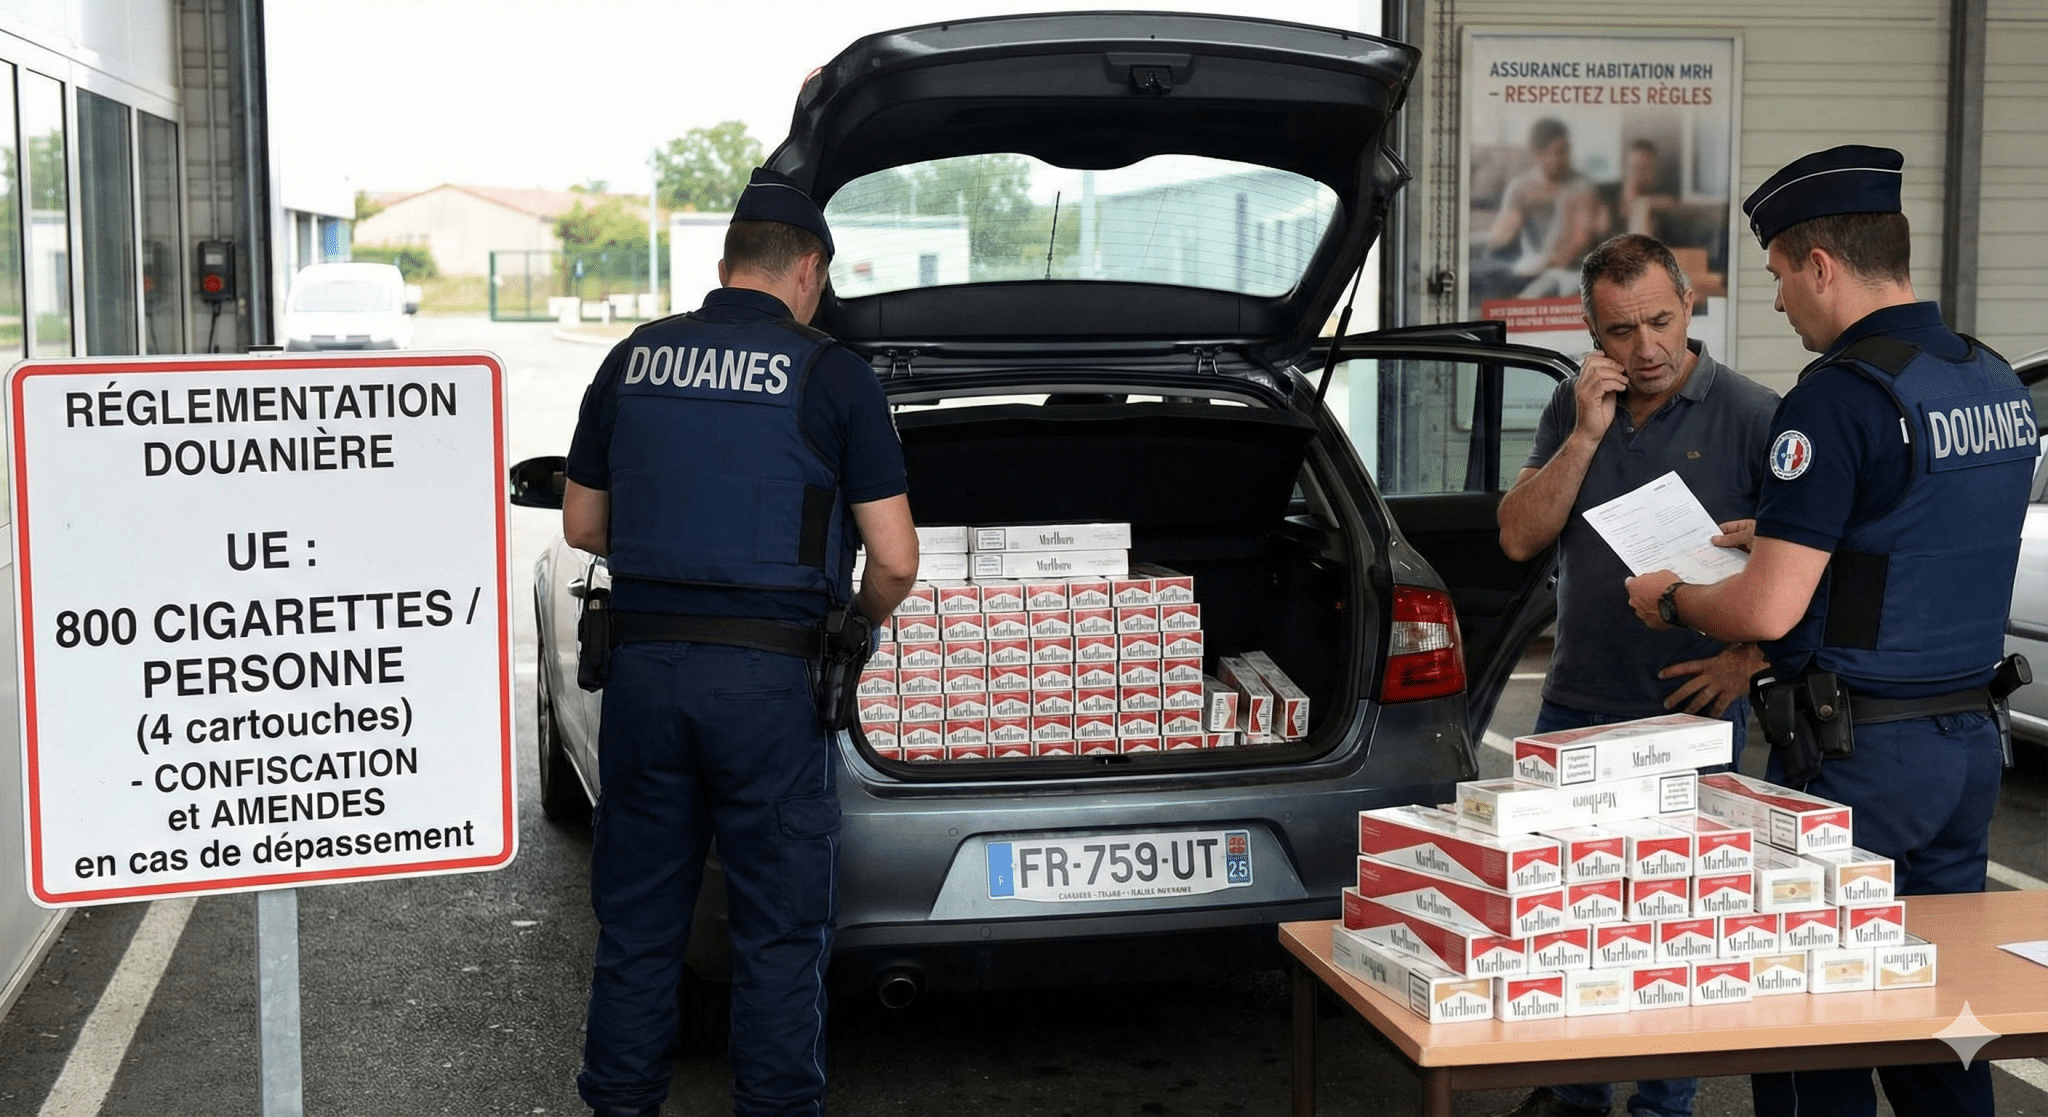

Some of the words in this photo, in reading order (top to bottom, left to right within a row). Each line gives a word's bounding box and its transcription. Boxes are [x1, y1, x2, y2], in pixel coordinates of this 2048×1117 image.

[1490, 62, 1581, 78] ASSURANCE
[1586, 62, 1675, 79] HABITATION
[1680, 64, 1713, 80] MRH
[1505, 85, 1604, 103] RESPECTEZ
[1609, 87, 1641, 104] LES
[1646, 82, 1713, 105] RÈGLES
[625, 346, 791, 395] DOUANES
[67, 382, 456, 427] RÉGLEMENTATION
[1928, 399, 2037, 459] DOUANES
[145, 427, 393, 476] DOUANIÈRE
[228, 531, 289, 570] UE
[56, 608, 136, 648] 800
[154, 590, 452, 642] CIGARETTES
[144, 647, 404, 698] PERSONNE
[138, 714, 172, 754] (4
[187, 697, 411, 743] cartouches)
[1632, 745, 1670, 768] Marlboro
[156, 748, 416, 793] CONFISCATION
[169, 804, 199, 831] et
[212, 788, 384, 827] AMENDES
[1807, 828, 1846, 847] Marlboro
[76, 855, 115, 878] en
[130, 850, 187, 874] cas
[201, 840, 240, 868] de
[253, 821, 475, 867] dépassement
[1019, 839, 1218, 888] FR-759-UT
[1229, 860, 1248, 879] 25
[1577, 856, 1620, 876] Marlboro
[1642, 855, 1685, 874] Marlboro
[1704, 850, 1747, 870] Marlboro
[1517, 866, 1556, 886] Marlboro
[1845, 881, 1887, 900] Marlboro
[1574, 900, 1616, 920] Marlboro
[1639, 897, 1683, 916] Marlboro
[1704, 893, 1747, 912] Marlboro
[1520, 909, 1560, 932] Marlboro
[1729, 932, 1773, 951] Marlboro
[1790, 927, 1833, 946] Marlboro
[1855, 923, 1898, 942] Marlboro
[1539, 947, 1584, 967] Marlboro
[1603, 942, 1647, 962] Marlboro
[1666, 937, 1711, 957] Marlboro
[1476, 953, 1521, 973] Marlboro
[1701, 980, 1746, 999] Marlboro
[1757, 970, 1801, 989] Marlboro
[1638, 984, 1683, 1004] Marlboro
[1440, 997, 1486, 1017] Marlboro
[1512, 995, 1558, 1016] Marlboro
